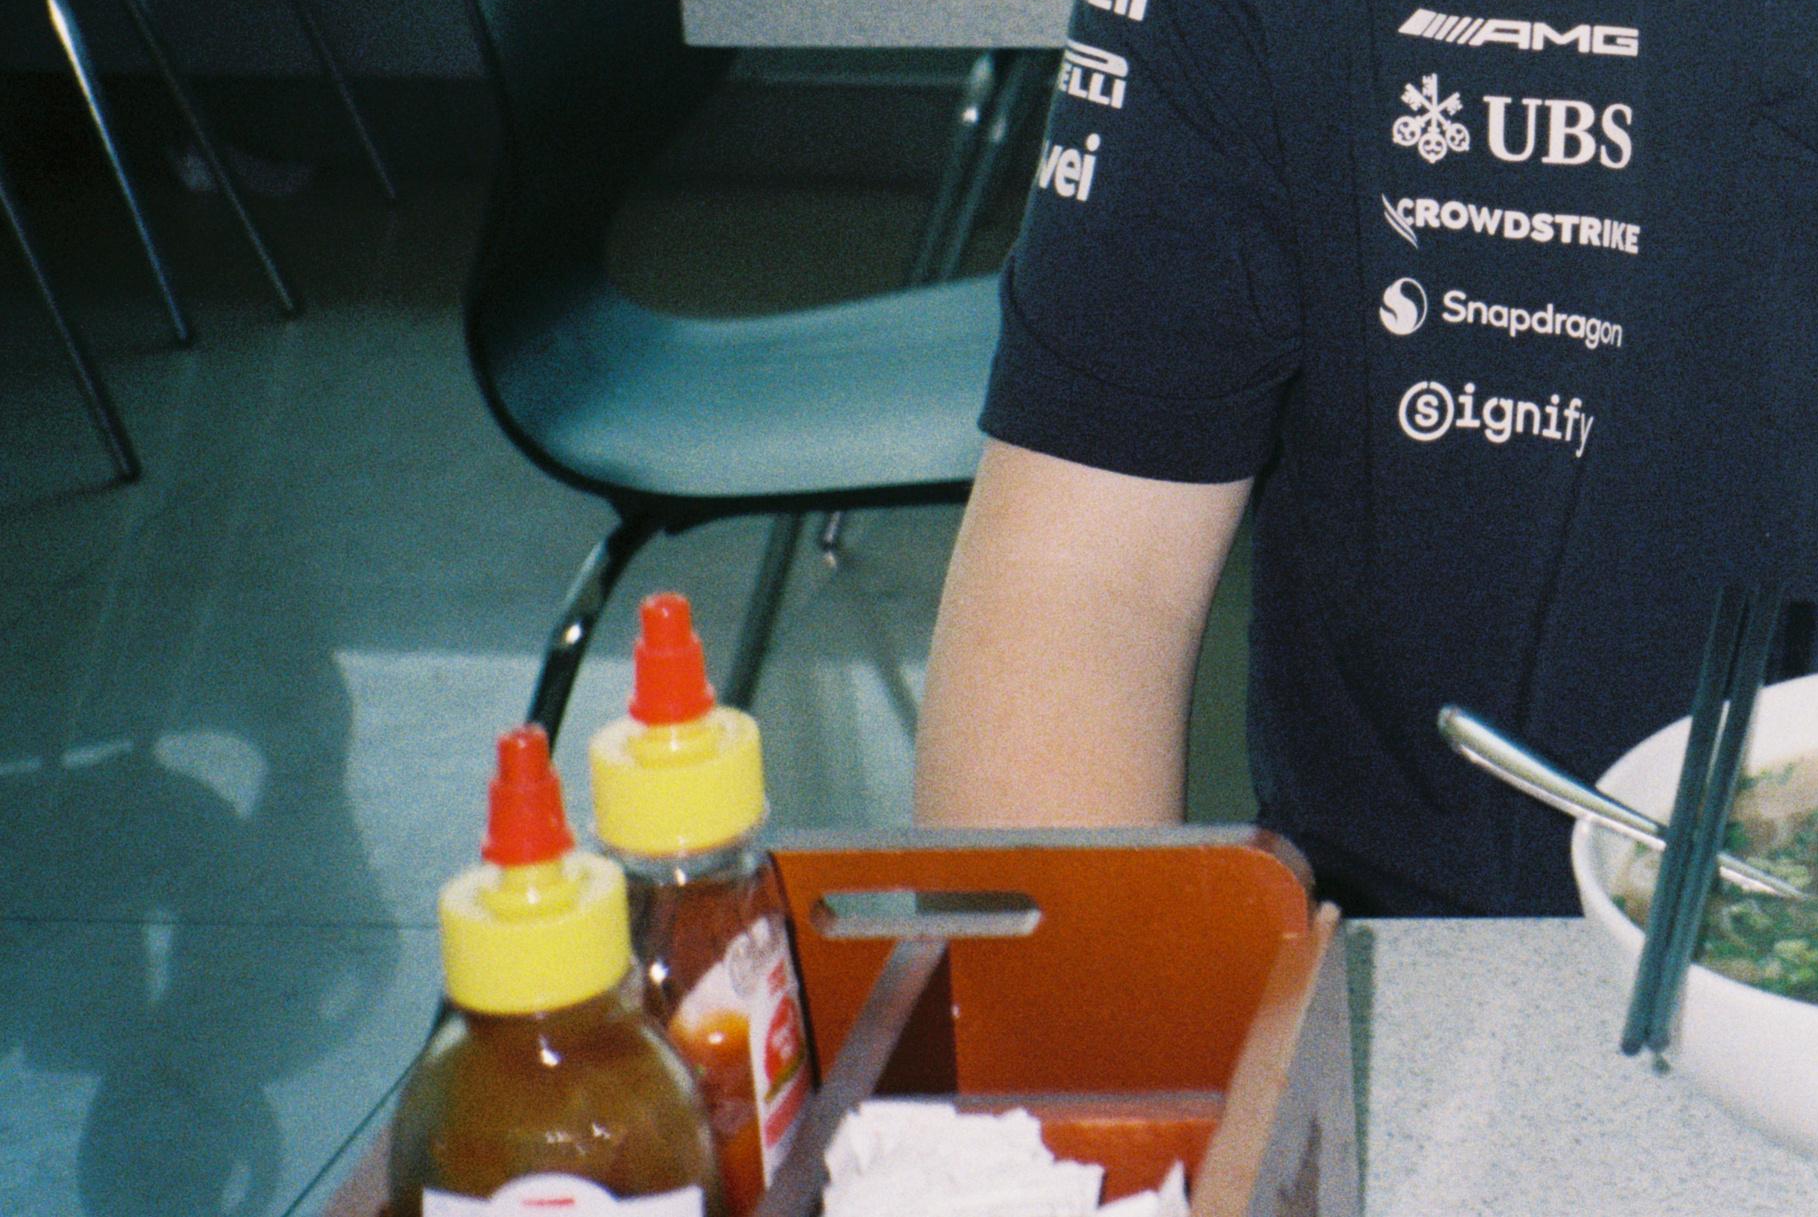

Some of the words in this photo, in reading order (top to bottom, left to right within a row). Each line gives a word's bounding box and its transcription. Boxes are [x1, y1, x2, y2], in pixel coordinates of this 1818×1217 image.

[1468, 18, 1640, 57] AMG
[1482, 95, 1633, 170] UBS
[1037, 132, 1101, 202] vei
[1396, 197, 1641, 255] CROWDSTRIKE
[1441, 289, 1623, 350] Snapdragon
